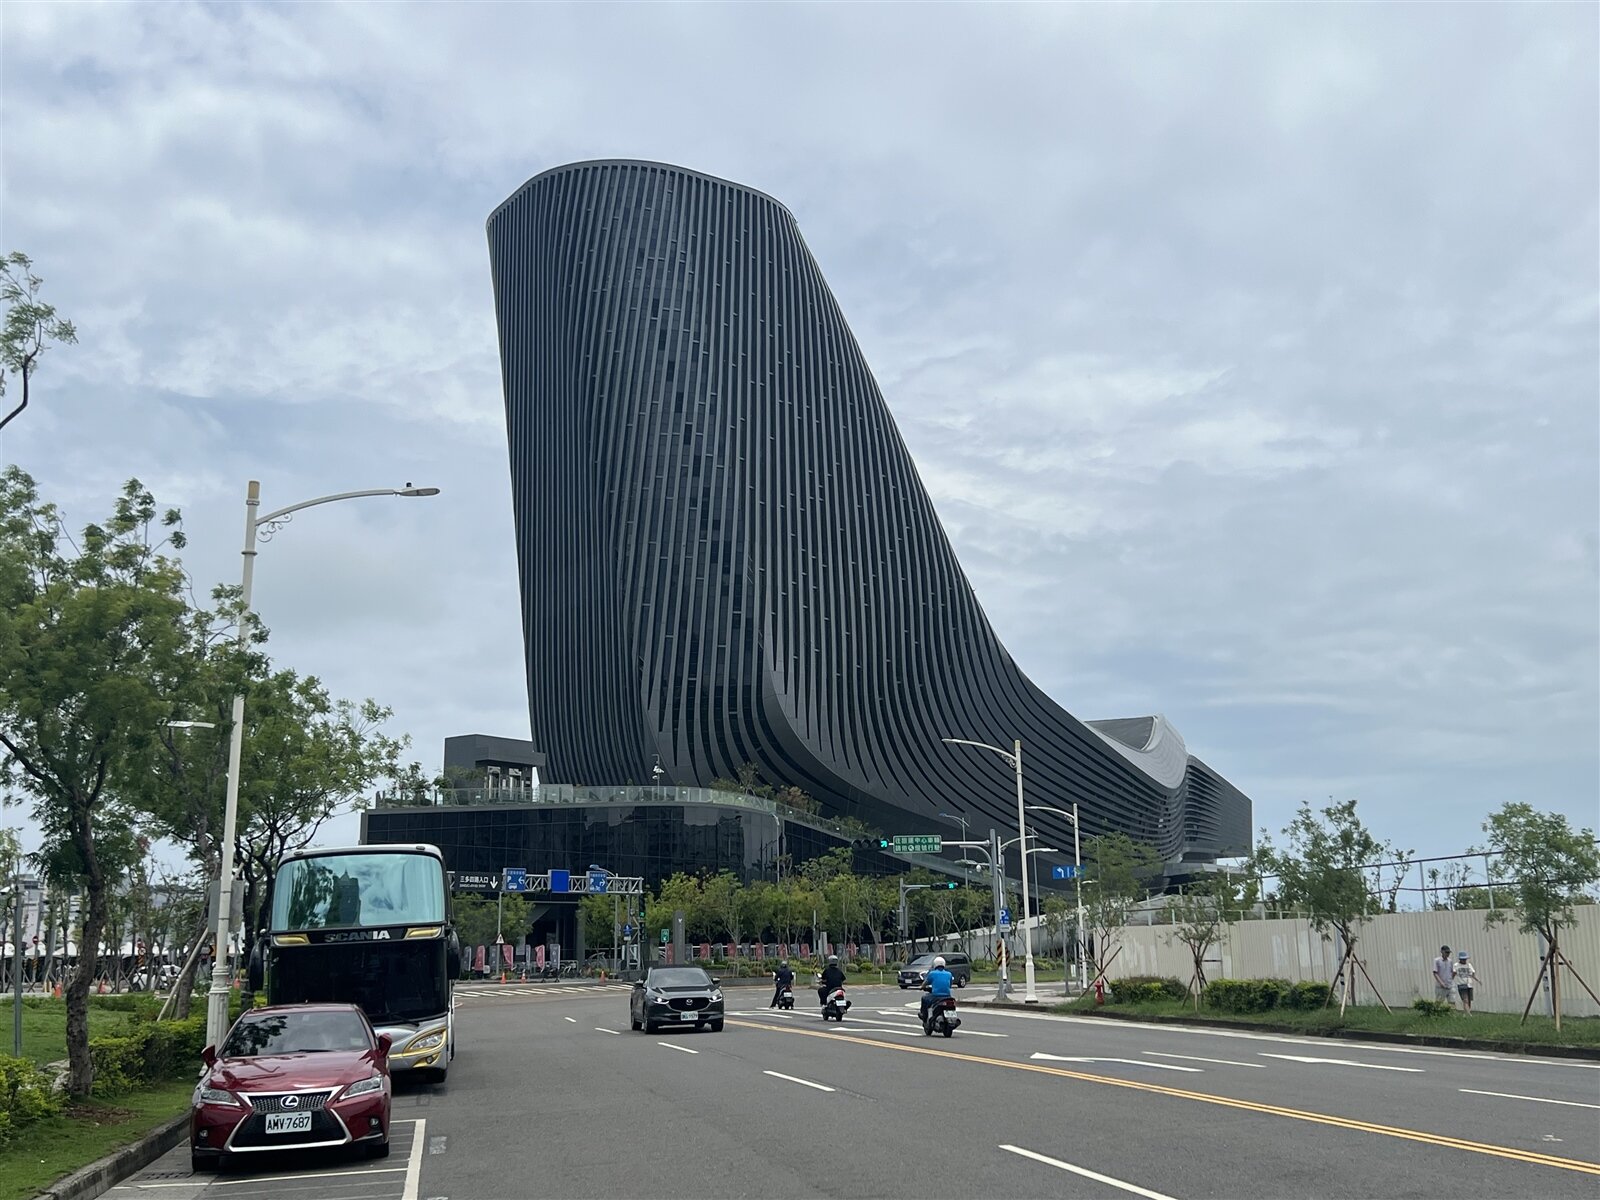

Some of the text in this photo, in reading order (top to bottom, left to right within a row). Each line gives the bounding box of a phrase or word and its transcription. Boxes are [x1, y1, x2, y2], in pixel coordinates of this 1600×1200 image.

[1000, 910, 1006, 919] P
[324, 930, 391, 943] SCANIA
[267, 1116, 310, 1130] AMV-7687
